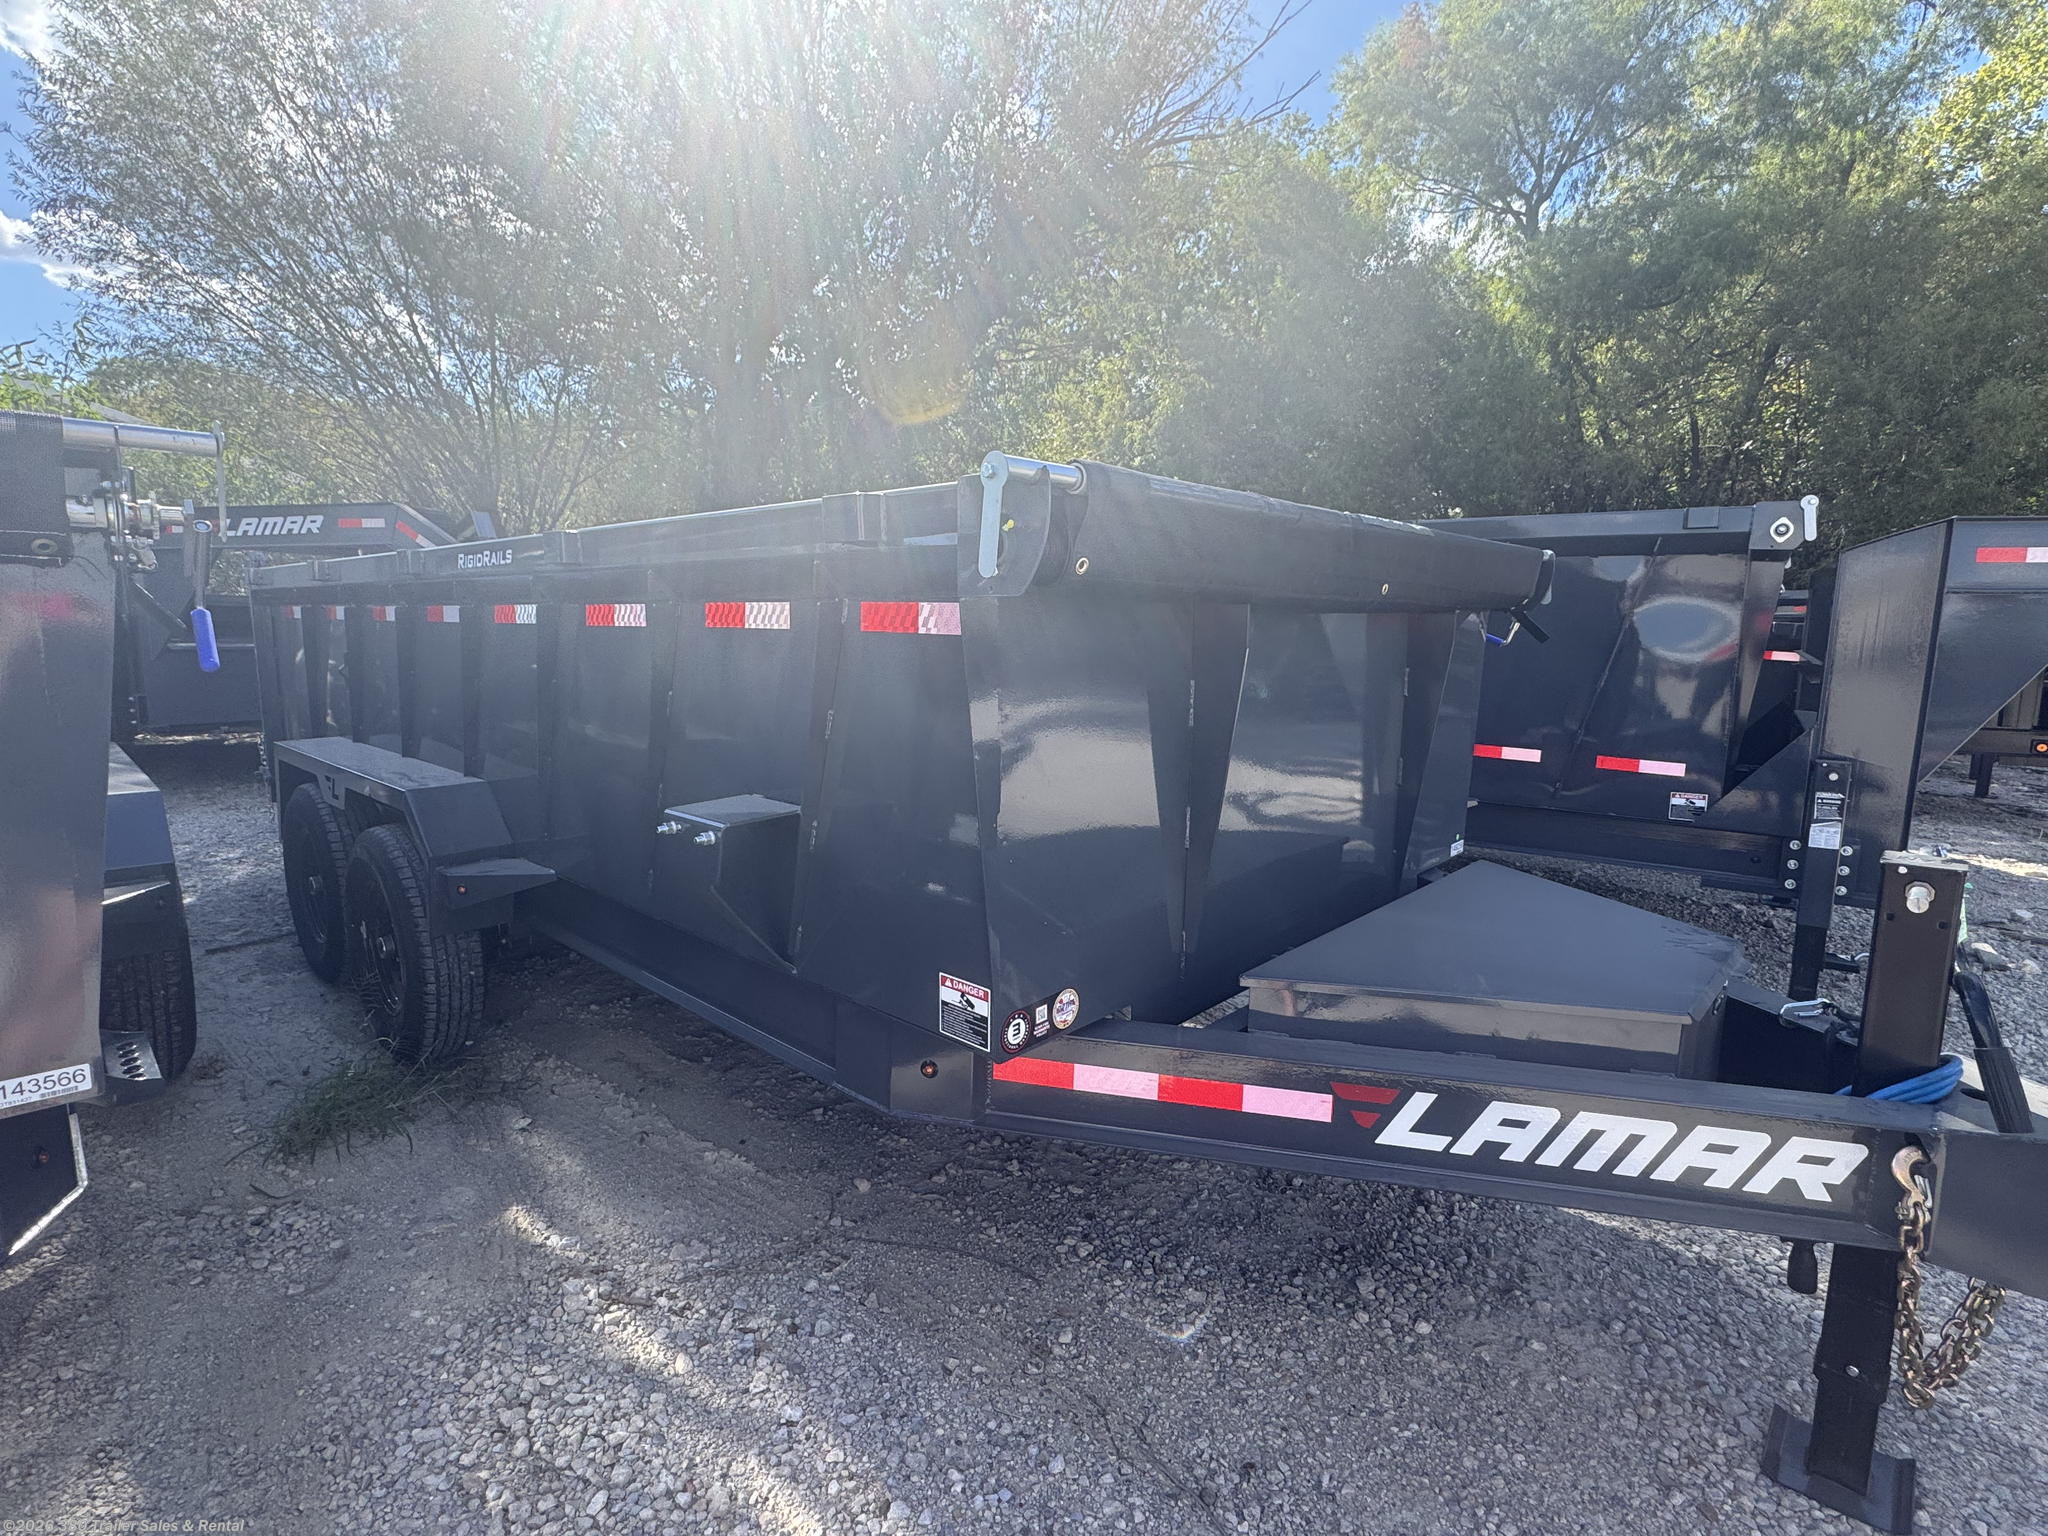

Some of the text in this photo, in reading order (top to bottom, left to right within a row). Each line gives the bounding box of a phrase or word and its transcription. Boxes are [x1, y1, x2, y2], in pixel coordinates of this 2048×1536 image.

[953, 980, 985, 999] DANGER
[0, 1068, 86, 1100] 143566
[1375, 1092, 1869, 1202] LAMAR
